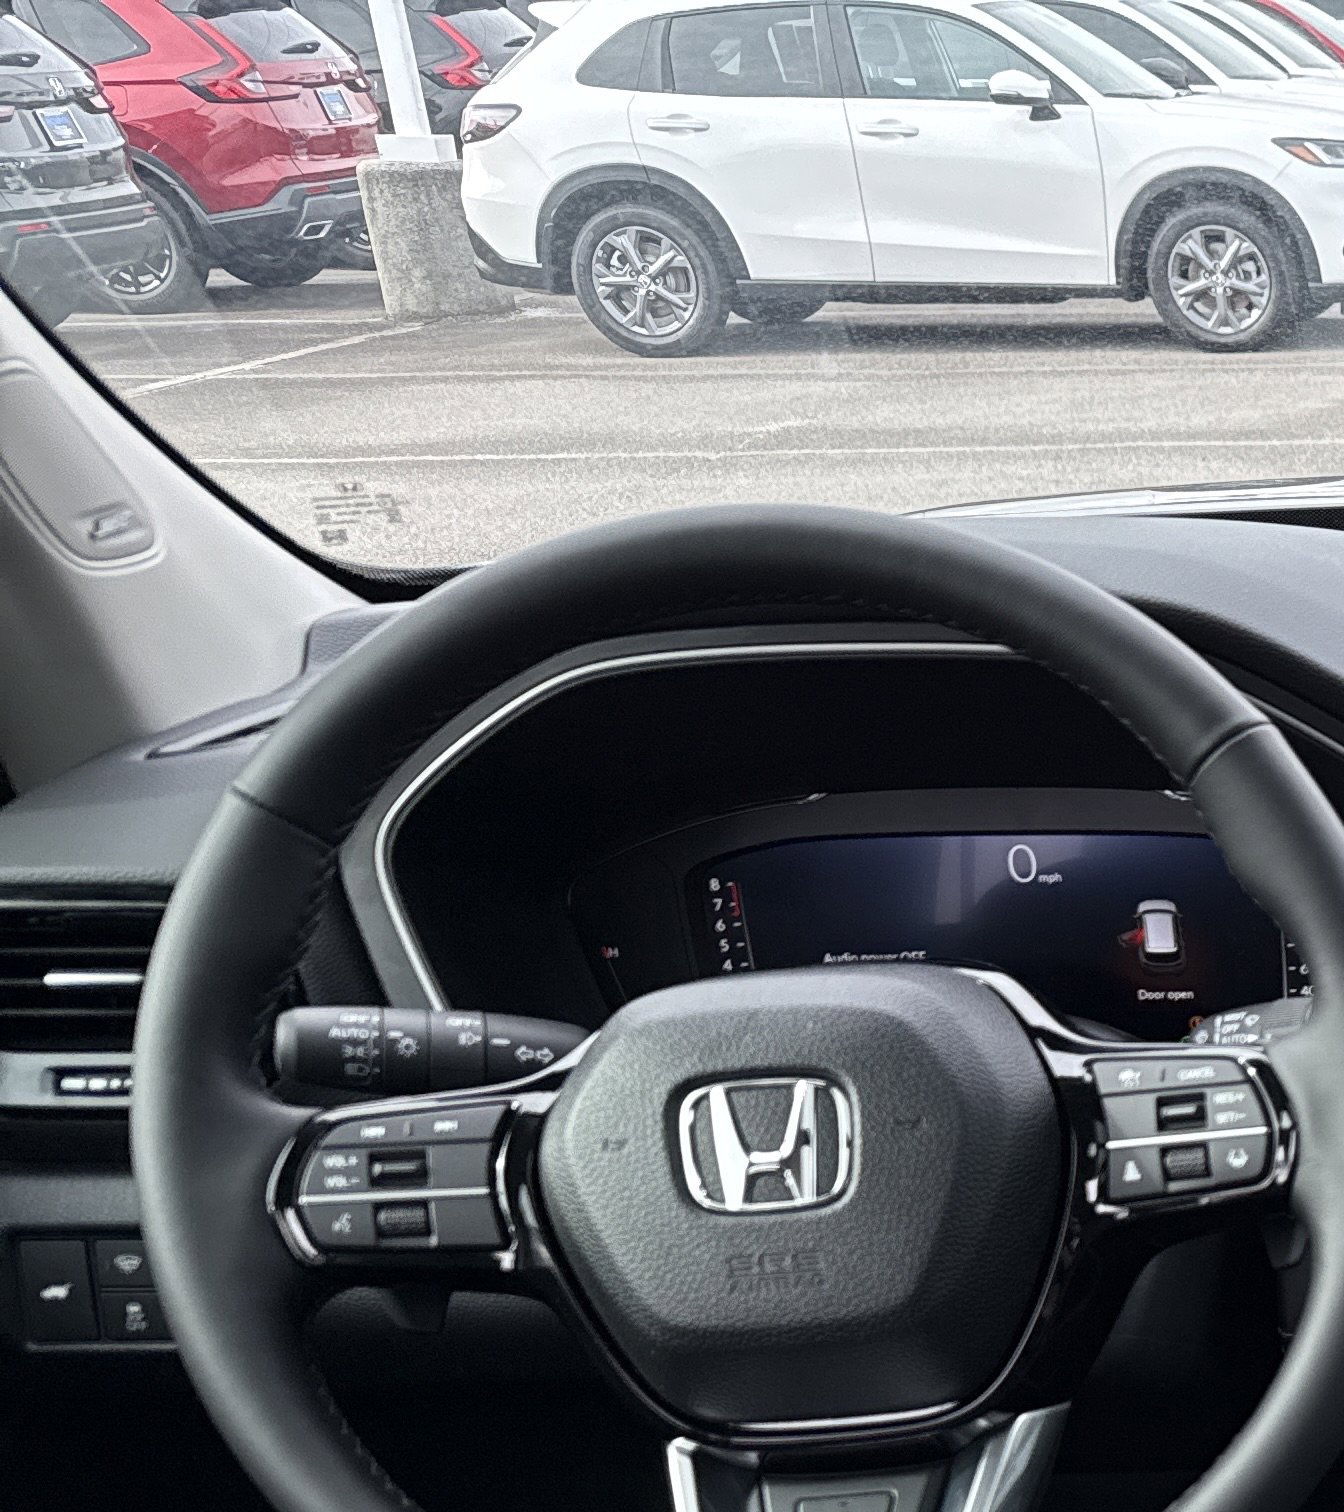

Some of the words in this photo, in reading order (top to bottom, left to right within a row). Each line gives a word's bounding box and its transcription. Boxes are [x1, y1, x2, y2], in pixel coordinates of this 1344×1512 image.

[1006, 843, 1038, 884] 0
[1038, 871, 1063, 885] mph
[708, 877, 722, 892] 8
[712, 898, 723, 912] 7
[714, 918, 727, 932] 6
[718, 938, 730, 952] 5
[722, 958, 733, 972] 4
[1137, 988, 1166, 1001] Door
[1167, 989, 1195, 1003] open
[1221, 1022, 1241, 1035] OFF
[1221, 1034, 1246, 1045] AUTO
[1177, 1066, 1216, 1081] CANCEL
